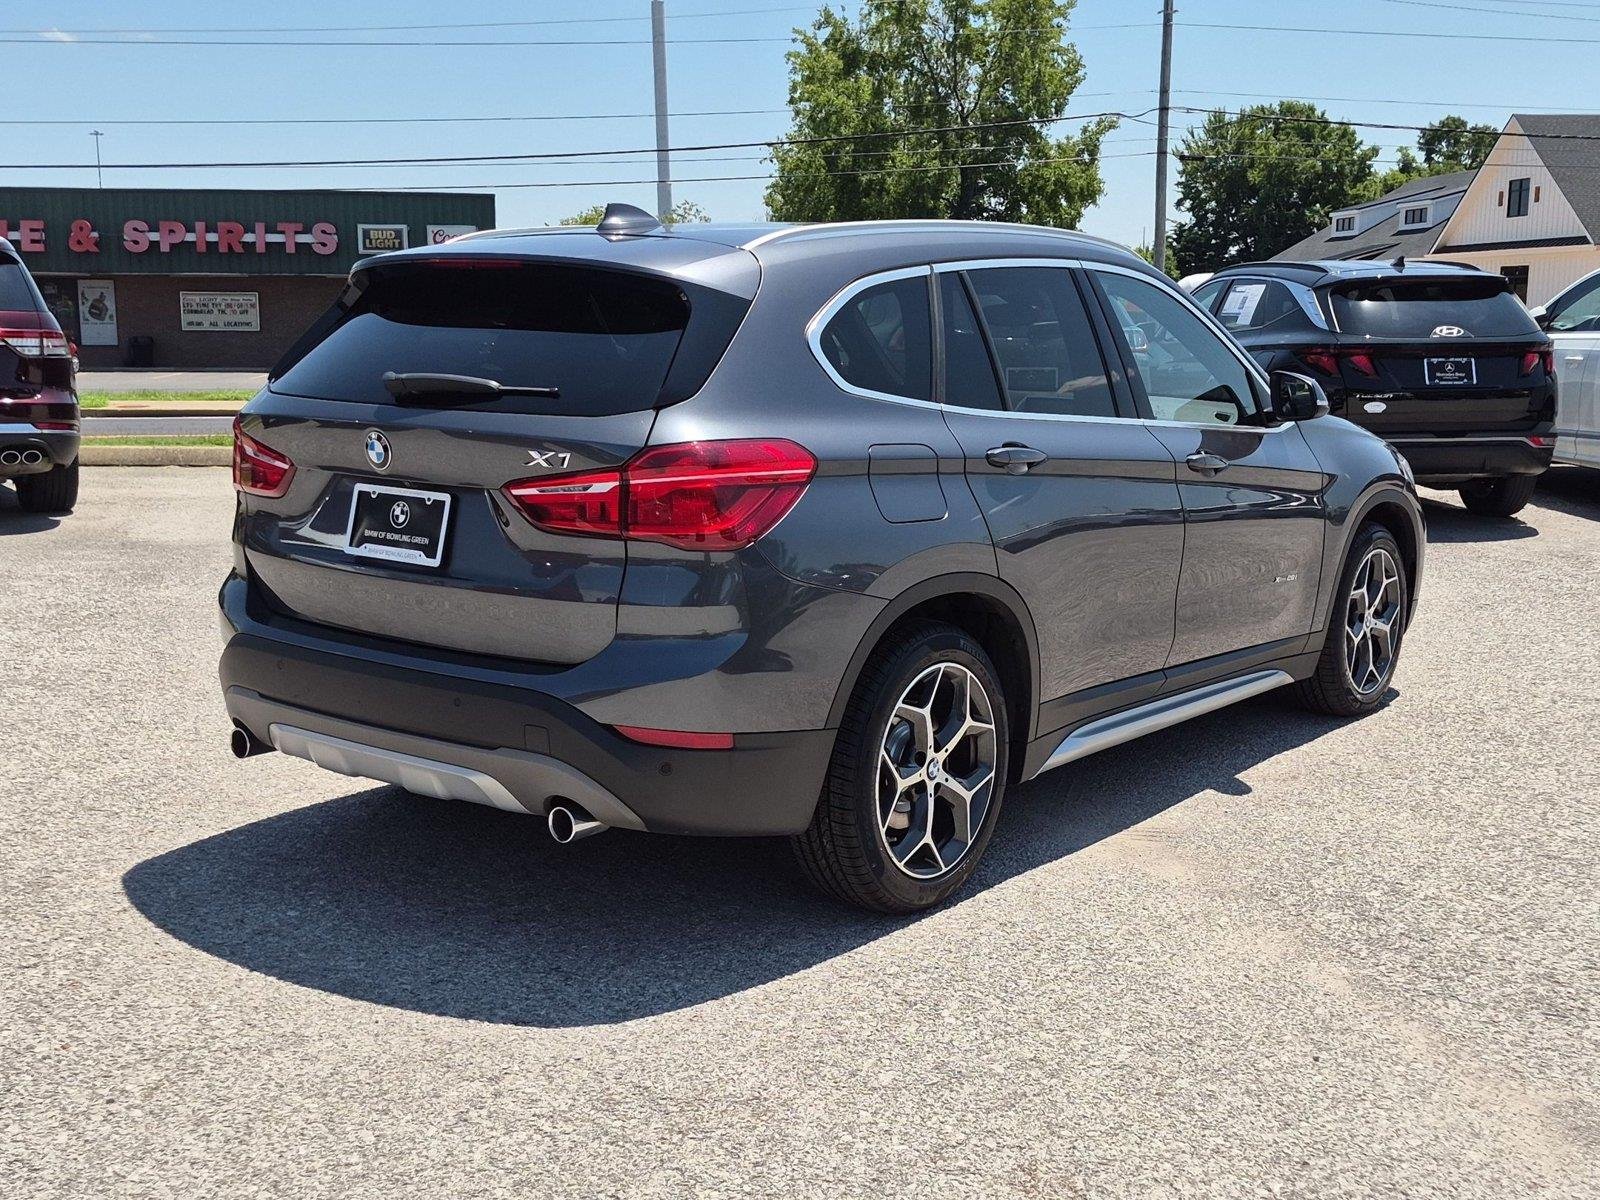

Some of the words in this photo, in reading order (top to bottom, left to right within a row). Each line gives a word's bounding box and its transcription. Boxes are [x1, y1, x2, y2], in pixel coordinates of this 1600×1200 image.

[68, 219, 100, 253] &
[123, 219, 338, 255] SPIRITS
[369, 230, 395, 239] BUD
[365, 239, 401, 248] LIGHT
[521, 450, 571, 469] X1
[364, 529, 378, 538] BMW
[378, 531, 386, 539] OF
[386, 532, 411, 543] BOWLING
[411, 535, 430, 545] GREEN
